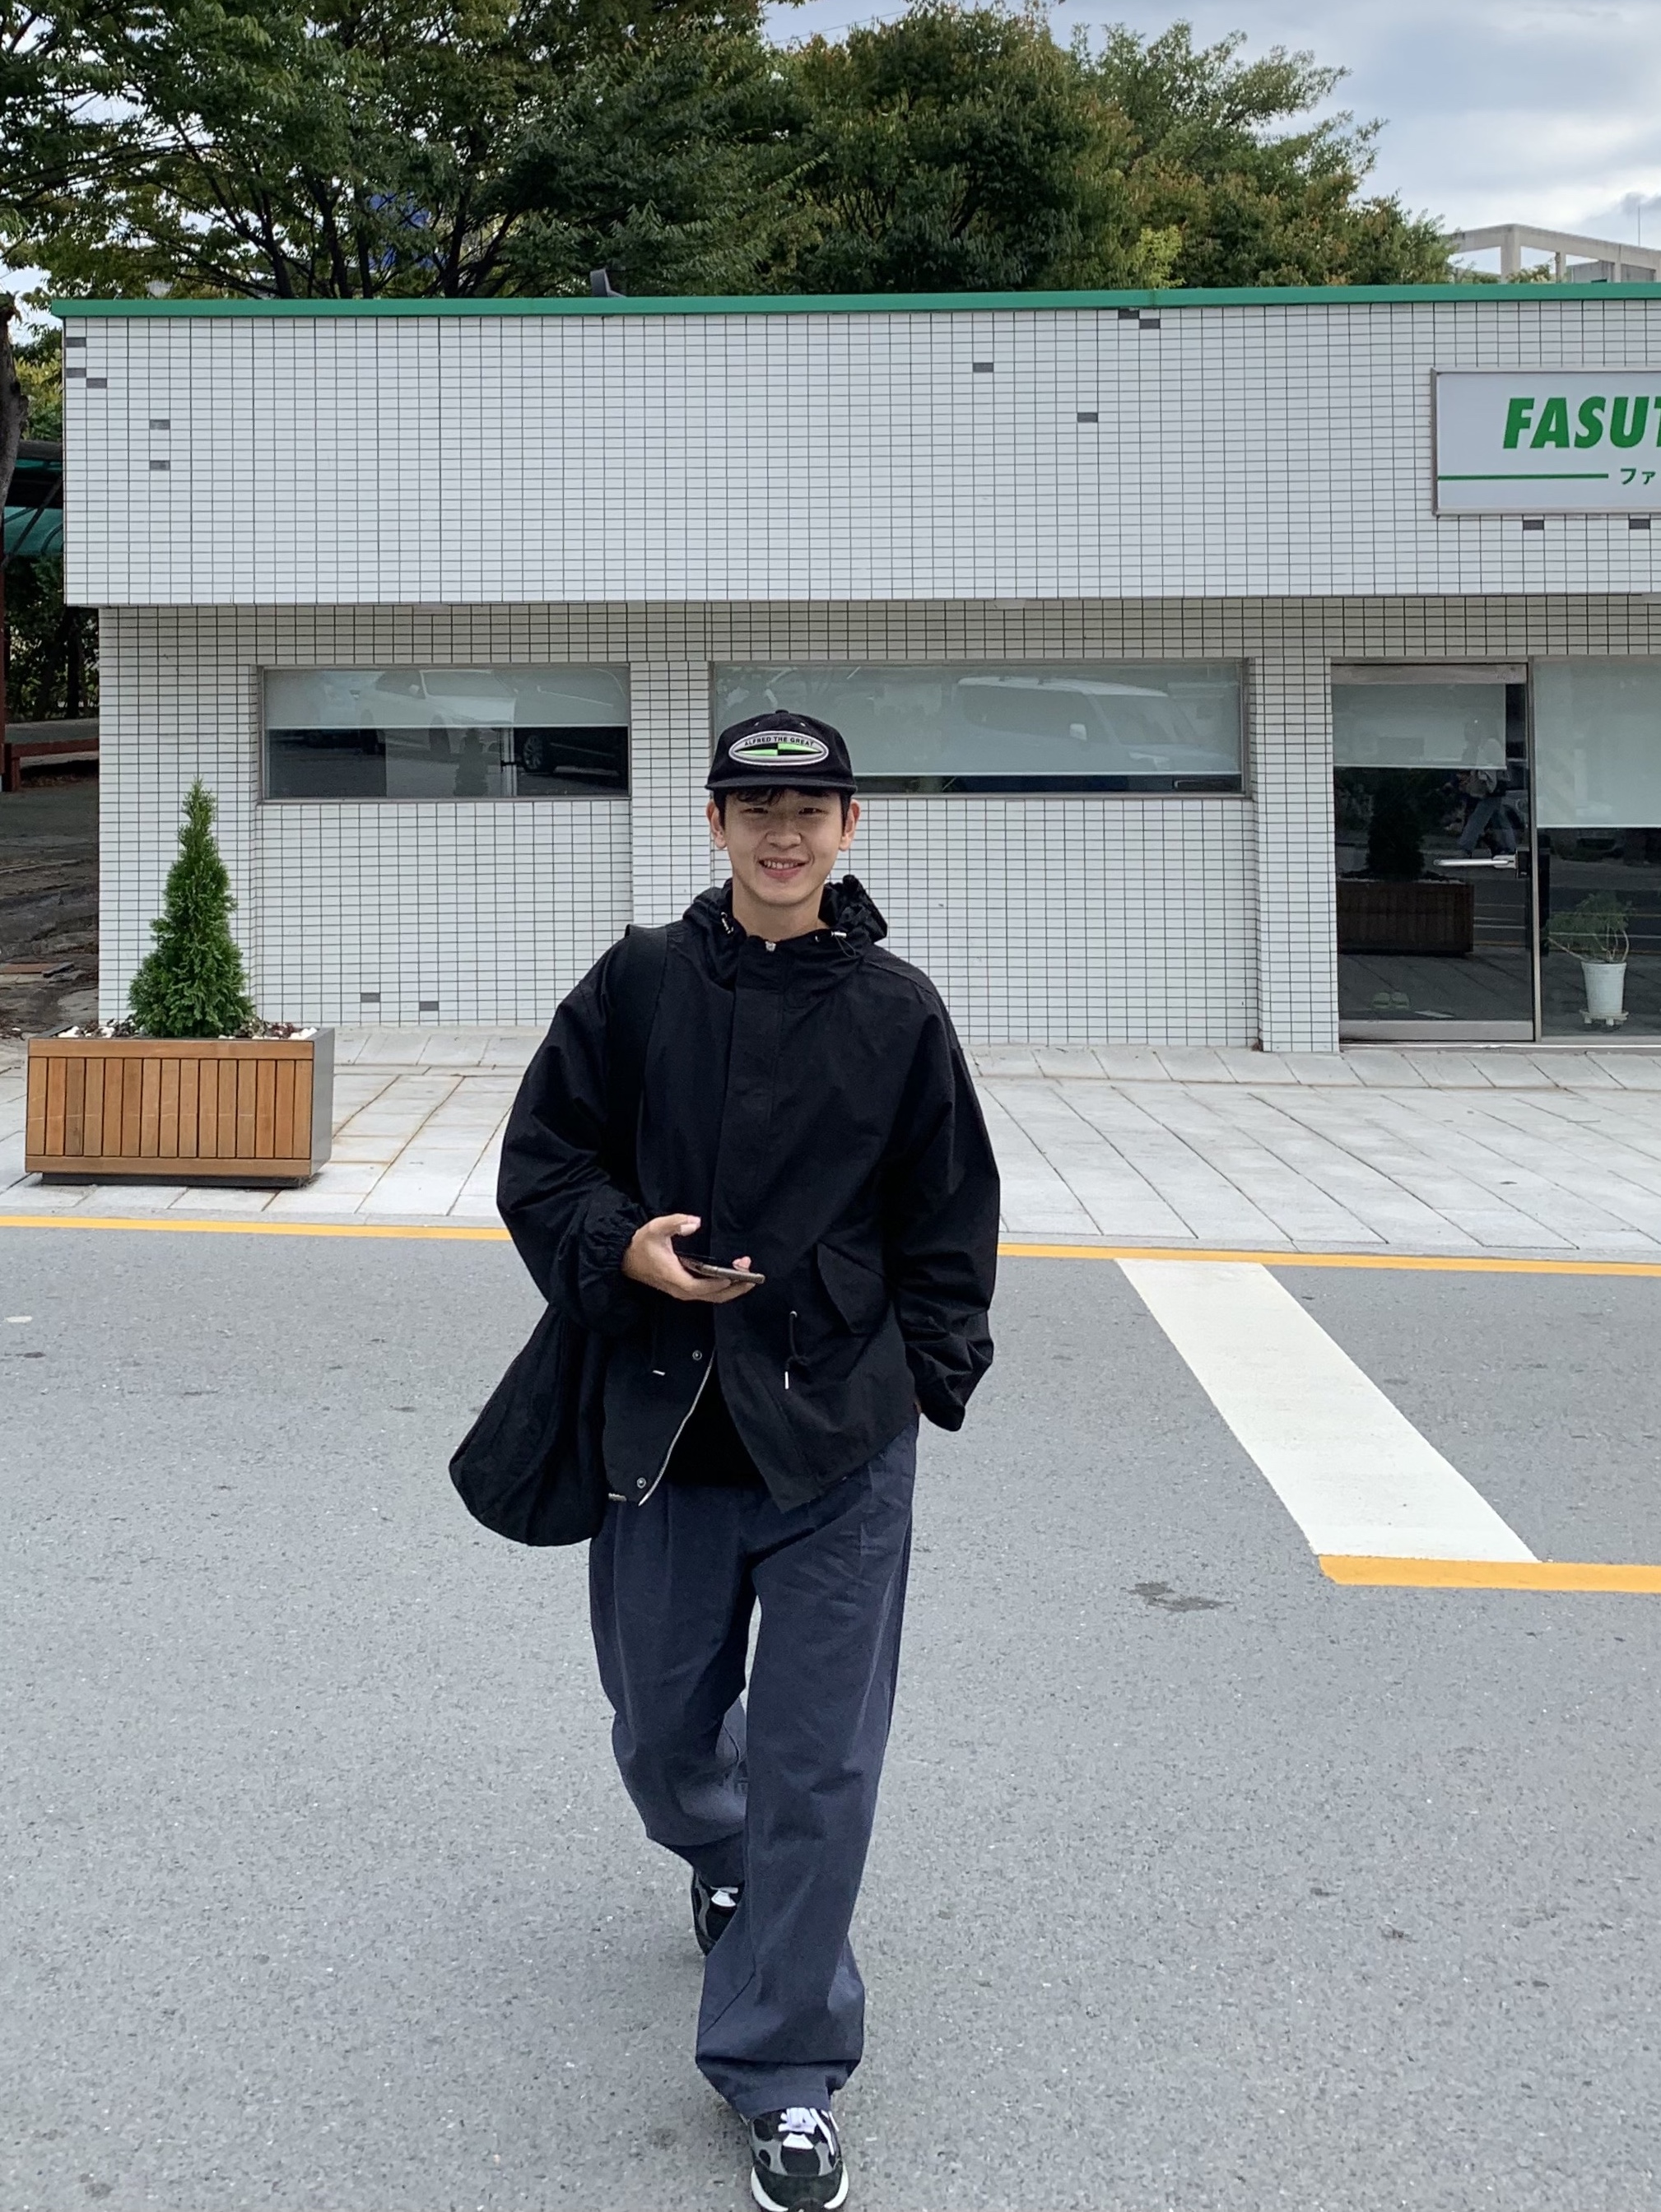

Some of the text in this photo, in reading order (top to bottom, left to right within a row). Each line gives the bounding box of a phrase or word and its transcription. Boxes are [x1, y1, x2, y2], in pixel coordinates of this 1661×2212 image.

[1503, 396, 1661, 448] FASU
[1620, 467, 1655, 485] ファ
[744, 737, 771, 746] ALFRED
[789, 737, 813, 746] GREAT
